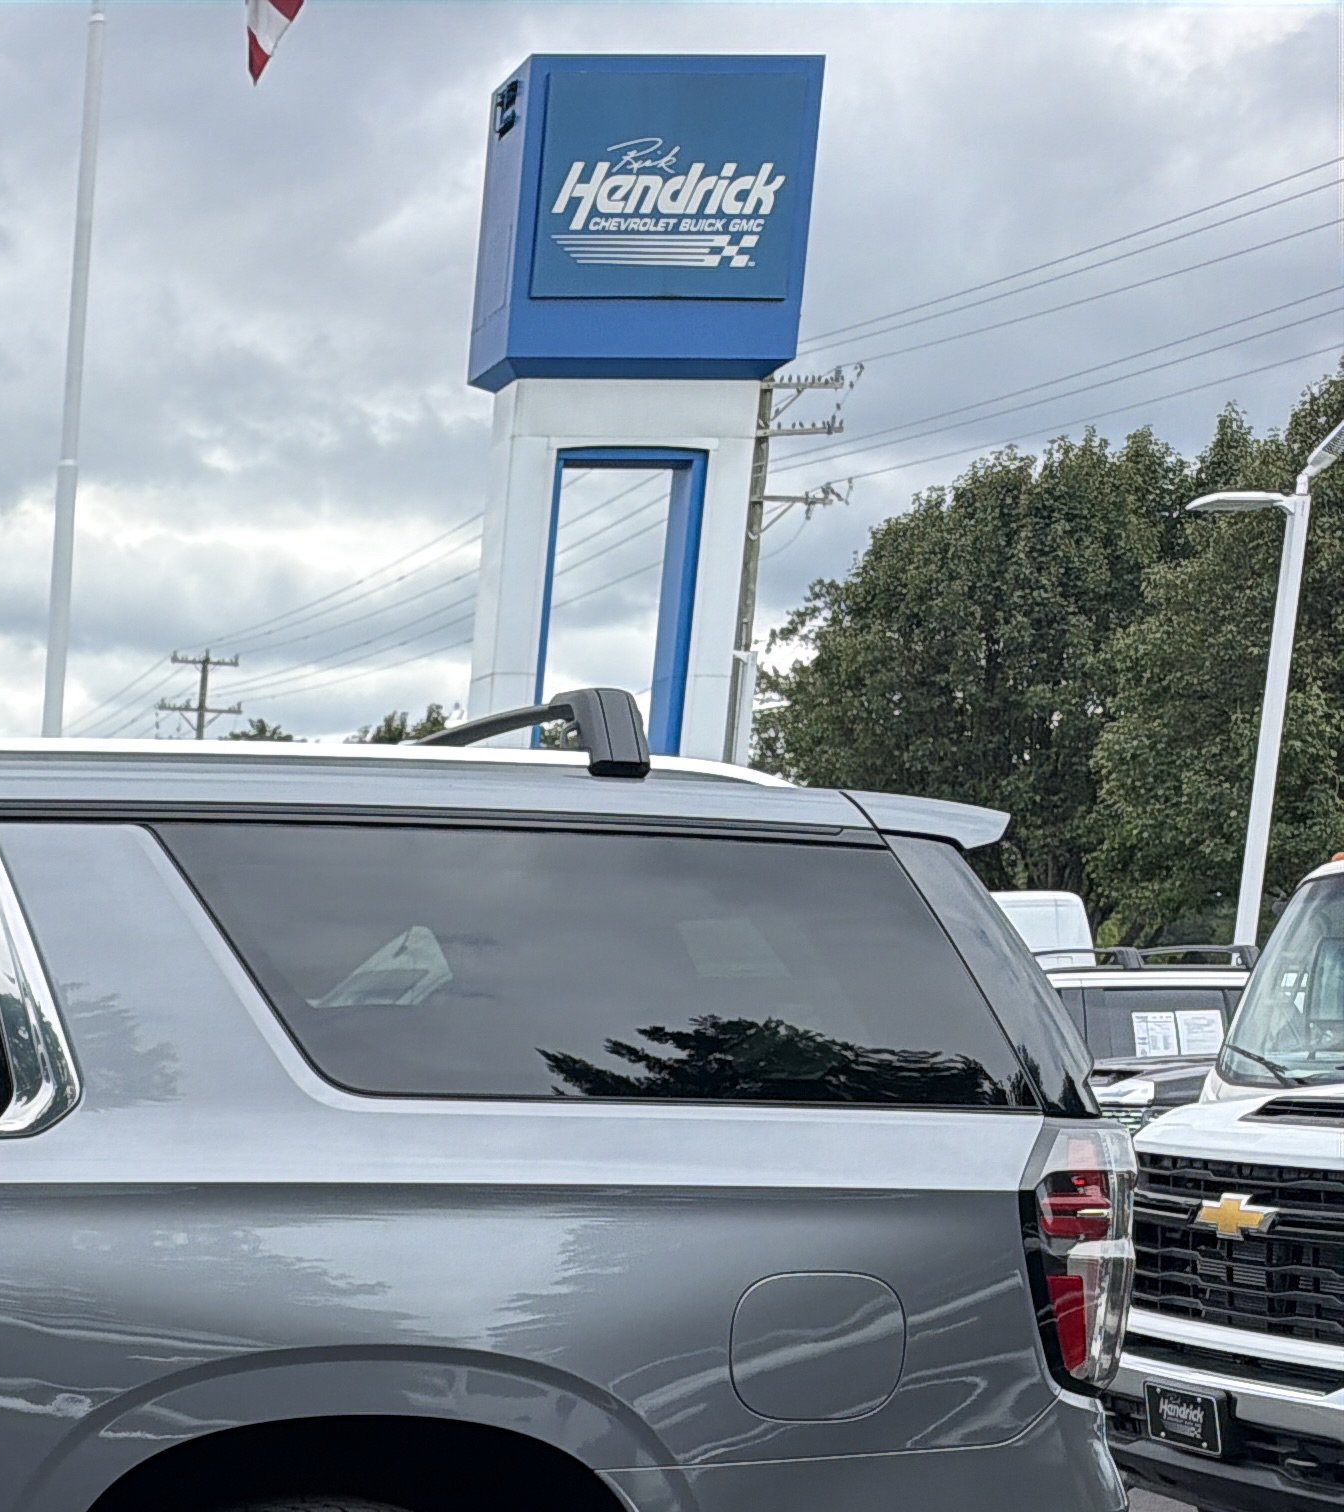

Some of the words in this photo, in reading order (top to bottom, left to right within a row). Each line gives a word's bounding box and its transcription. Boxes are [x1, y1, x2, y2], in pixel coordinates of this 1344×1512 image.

[551, 161, 786, 231] Hendrick
[588, 217, 676, 231] CHEVROLET
[679, 218, 727, 232] BUICK
[728, 218, 765, 232] GMC
[1158, 1396, 1205, 1423] Hendrick
